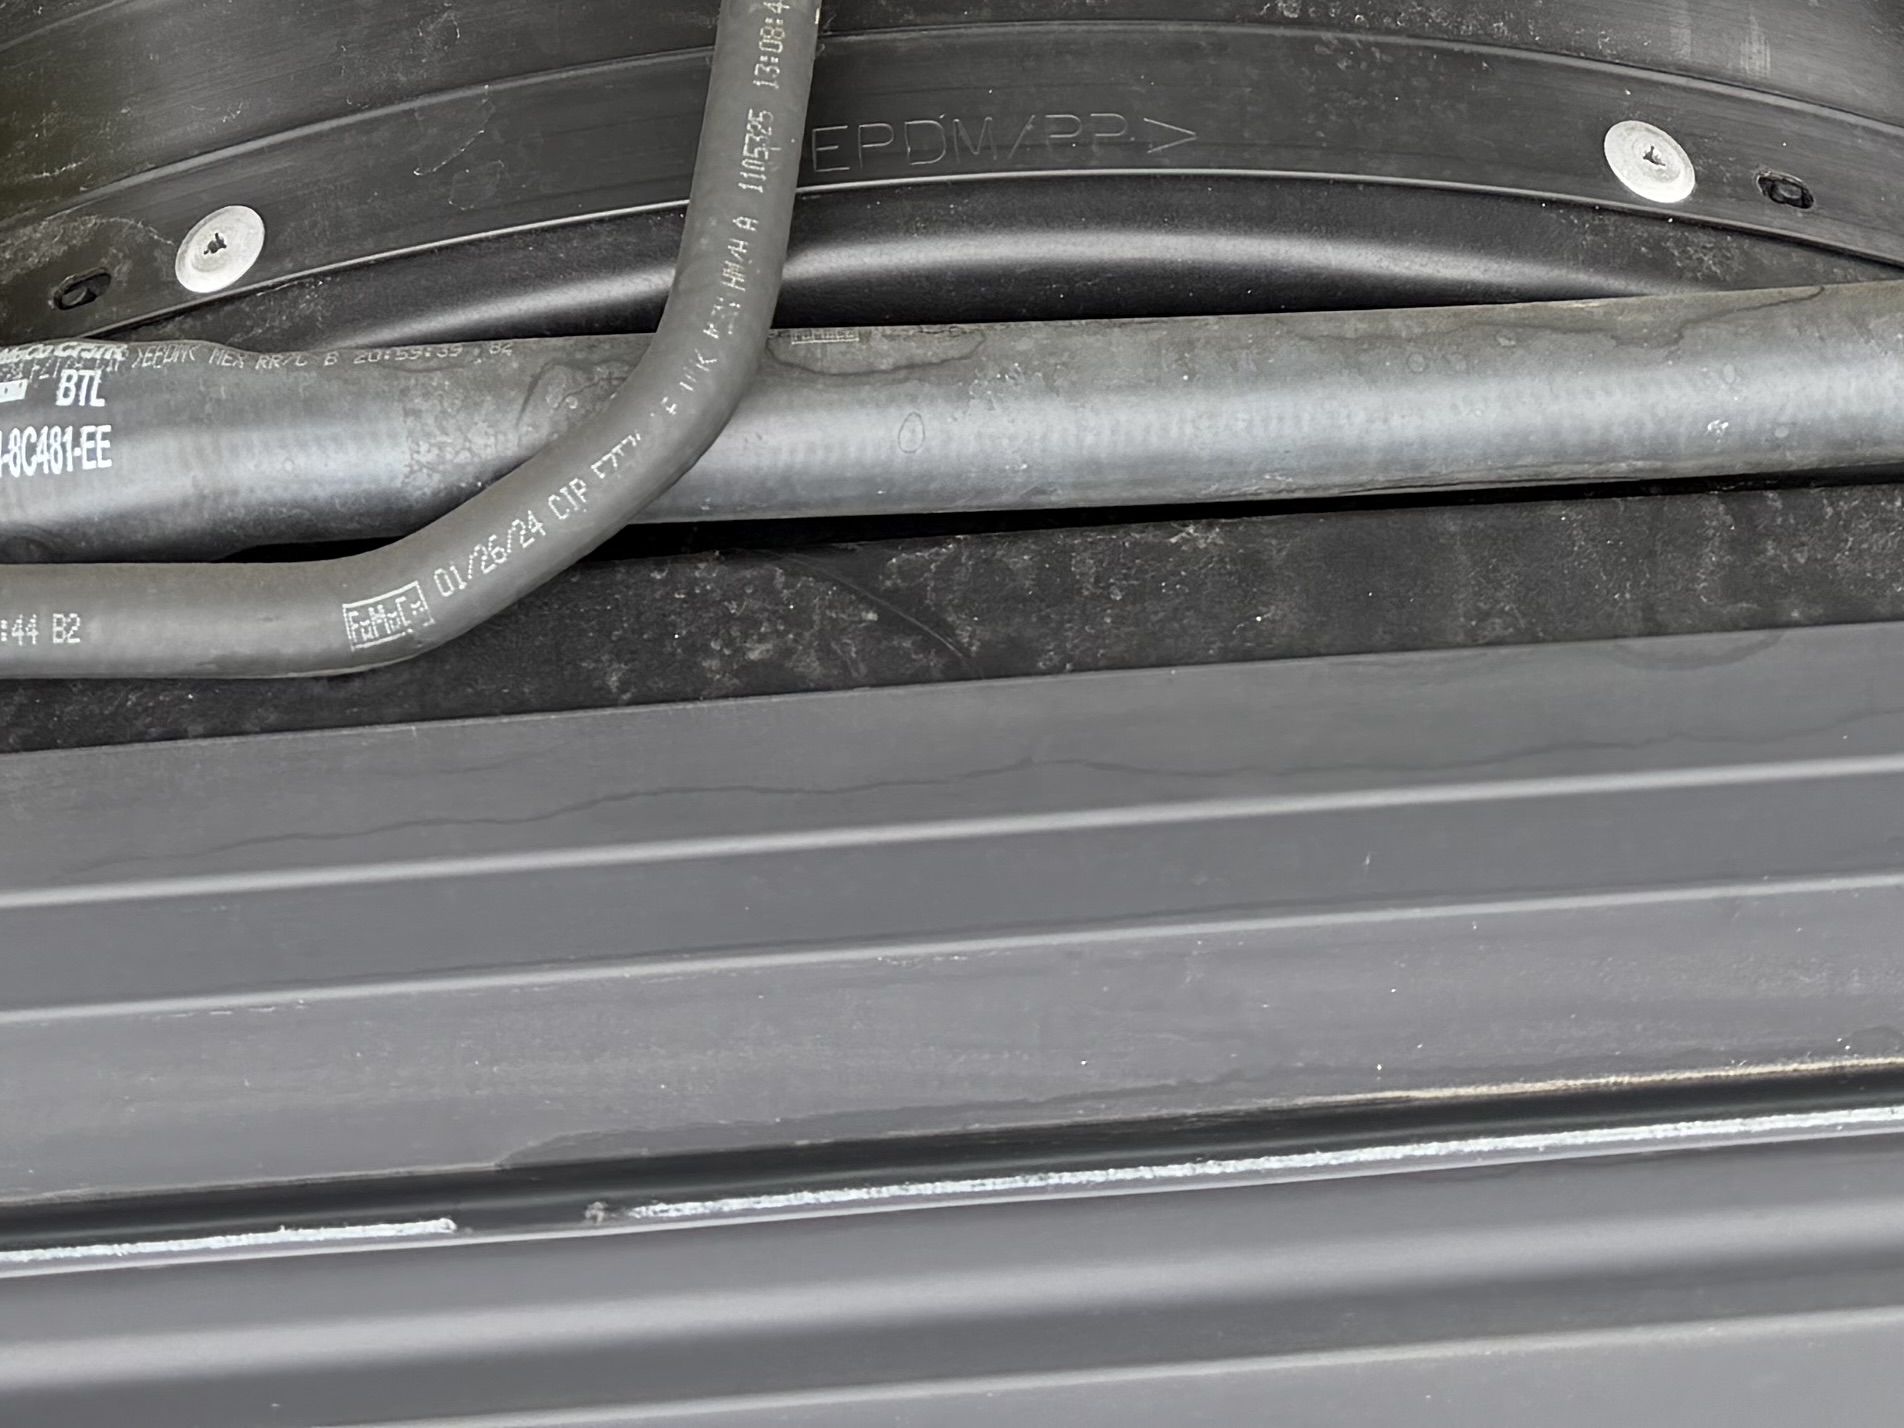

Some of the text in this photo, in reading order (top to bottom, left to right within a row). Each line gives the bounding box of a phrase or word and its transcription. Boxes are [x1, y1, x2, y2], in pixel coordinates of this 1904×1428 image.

[738, 108, 774, 193] 1105325
[732, 216, 759, 231] A
[55, 369, 107, 407] BTL
[434, 510, 546, 597] 01/26/24
[52, 612, 82, 644] B2
